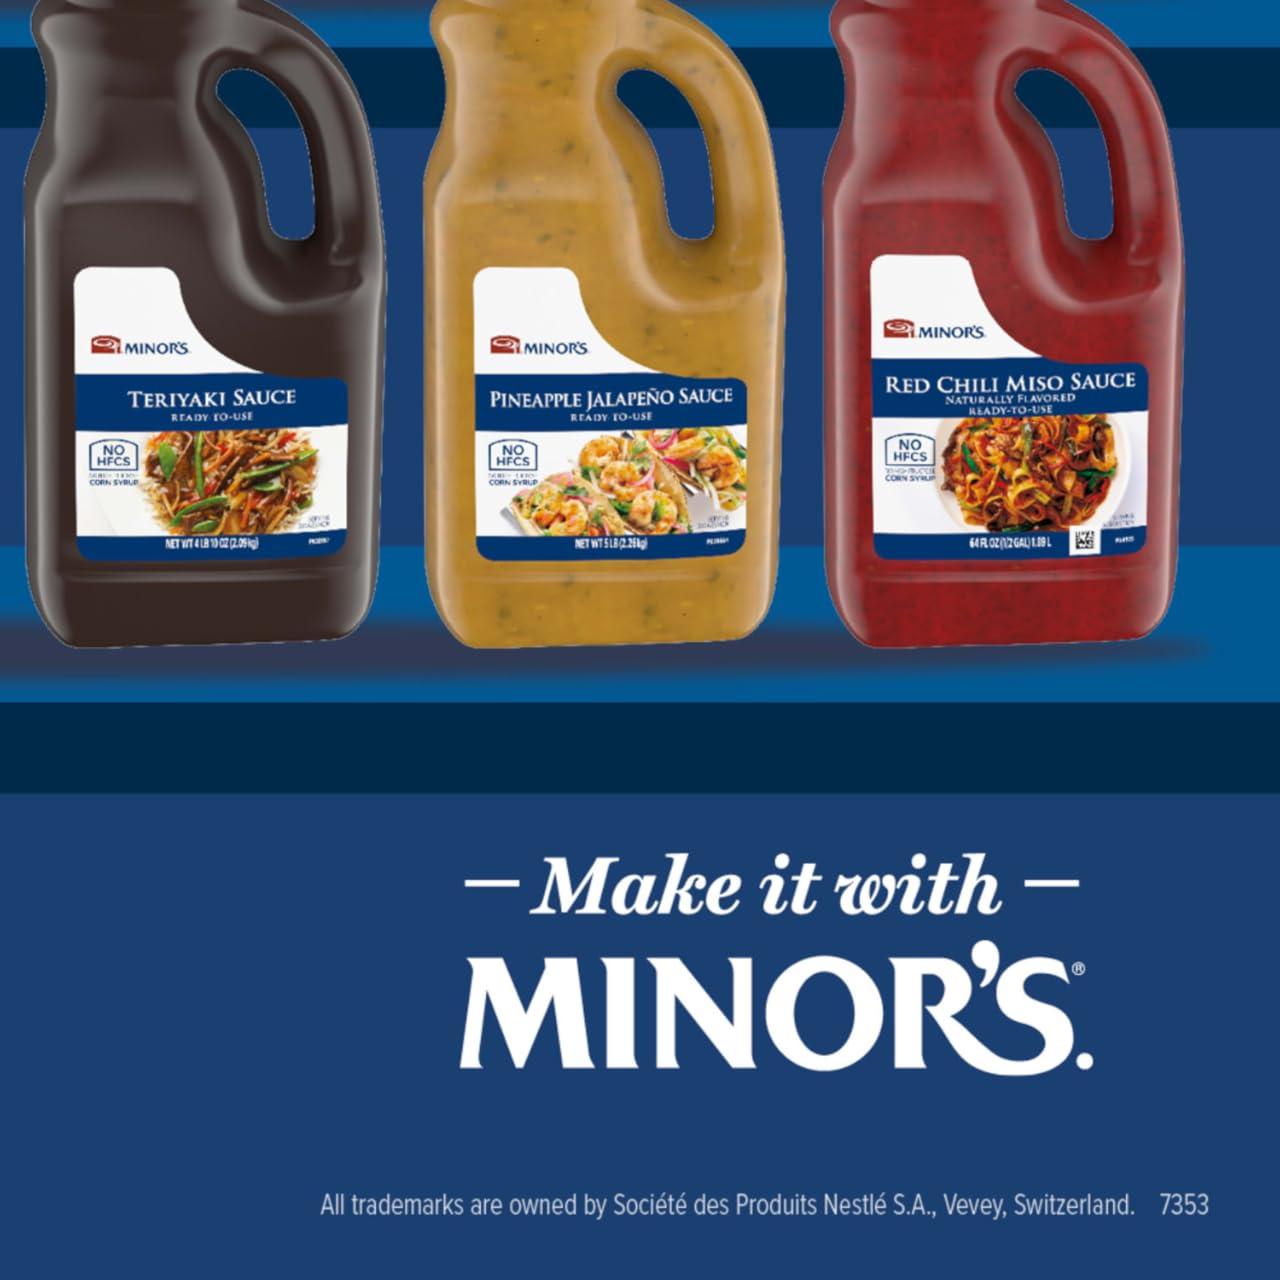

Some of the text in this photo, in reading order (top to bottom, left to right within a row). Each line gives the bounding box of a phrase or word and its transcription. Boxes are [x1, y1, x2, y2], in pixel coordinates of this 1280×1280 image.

[919, 325, 984, 339] MINOR'S
[125, 341, 189, 355] MINOR'S
[524, 341, 588, 355] MINOR'S
[886, 373, 1136, 393] RED CHILI MISO SAUCE
[127, 389, 296, 408] TERIYAKI SAUCE
[490, 388, 733, 411] PINEAPPLE JALAPEÑO SAUCE
[945, 393, 1076, 405] NATURALLY FLAVORED
[103, 445, 125, 455] NO
[502, 445, 524, 455] NO
[899, 440, 921, 450] NO
[97, 456, 131, 466] HFCS
[496, 456, 530, 466] HFCS
[893, 451, 927, 462] HFCS
